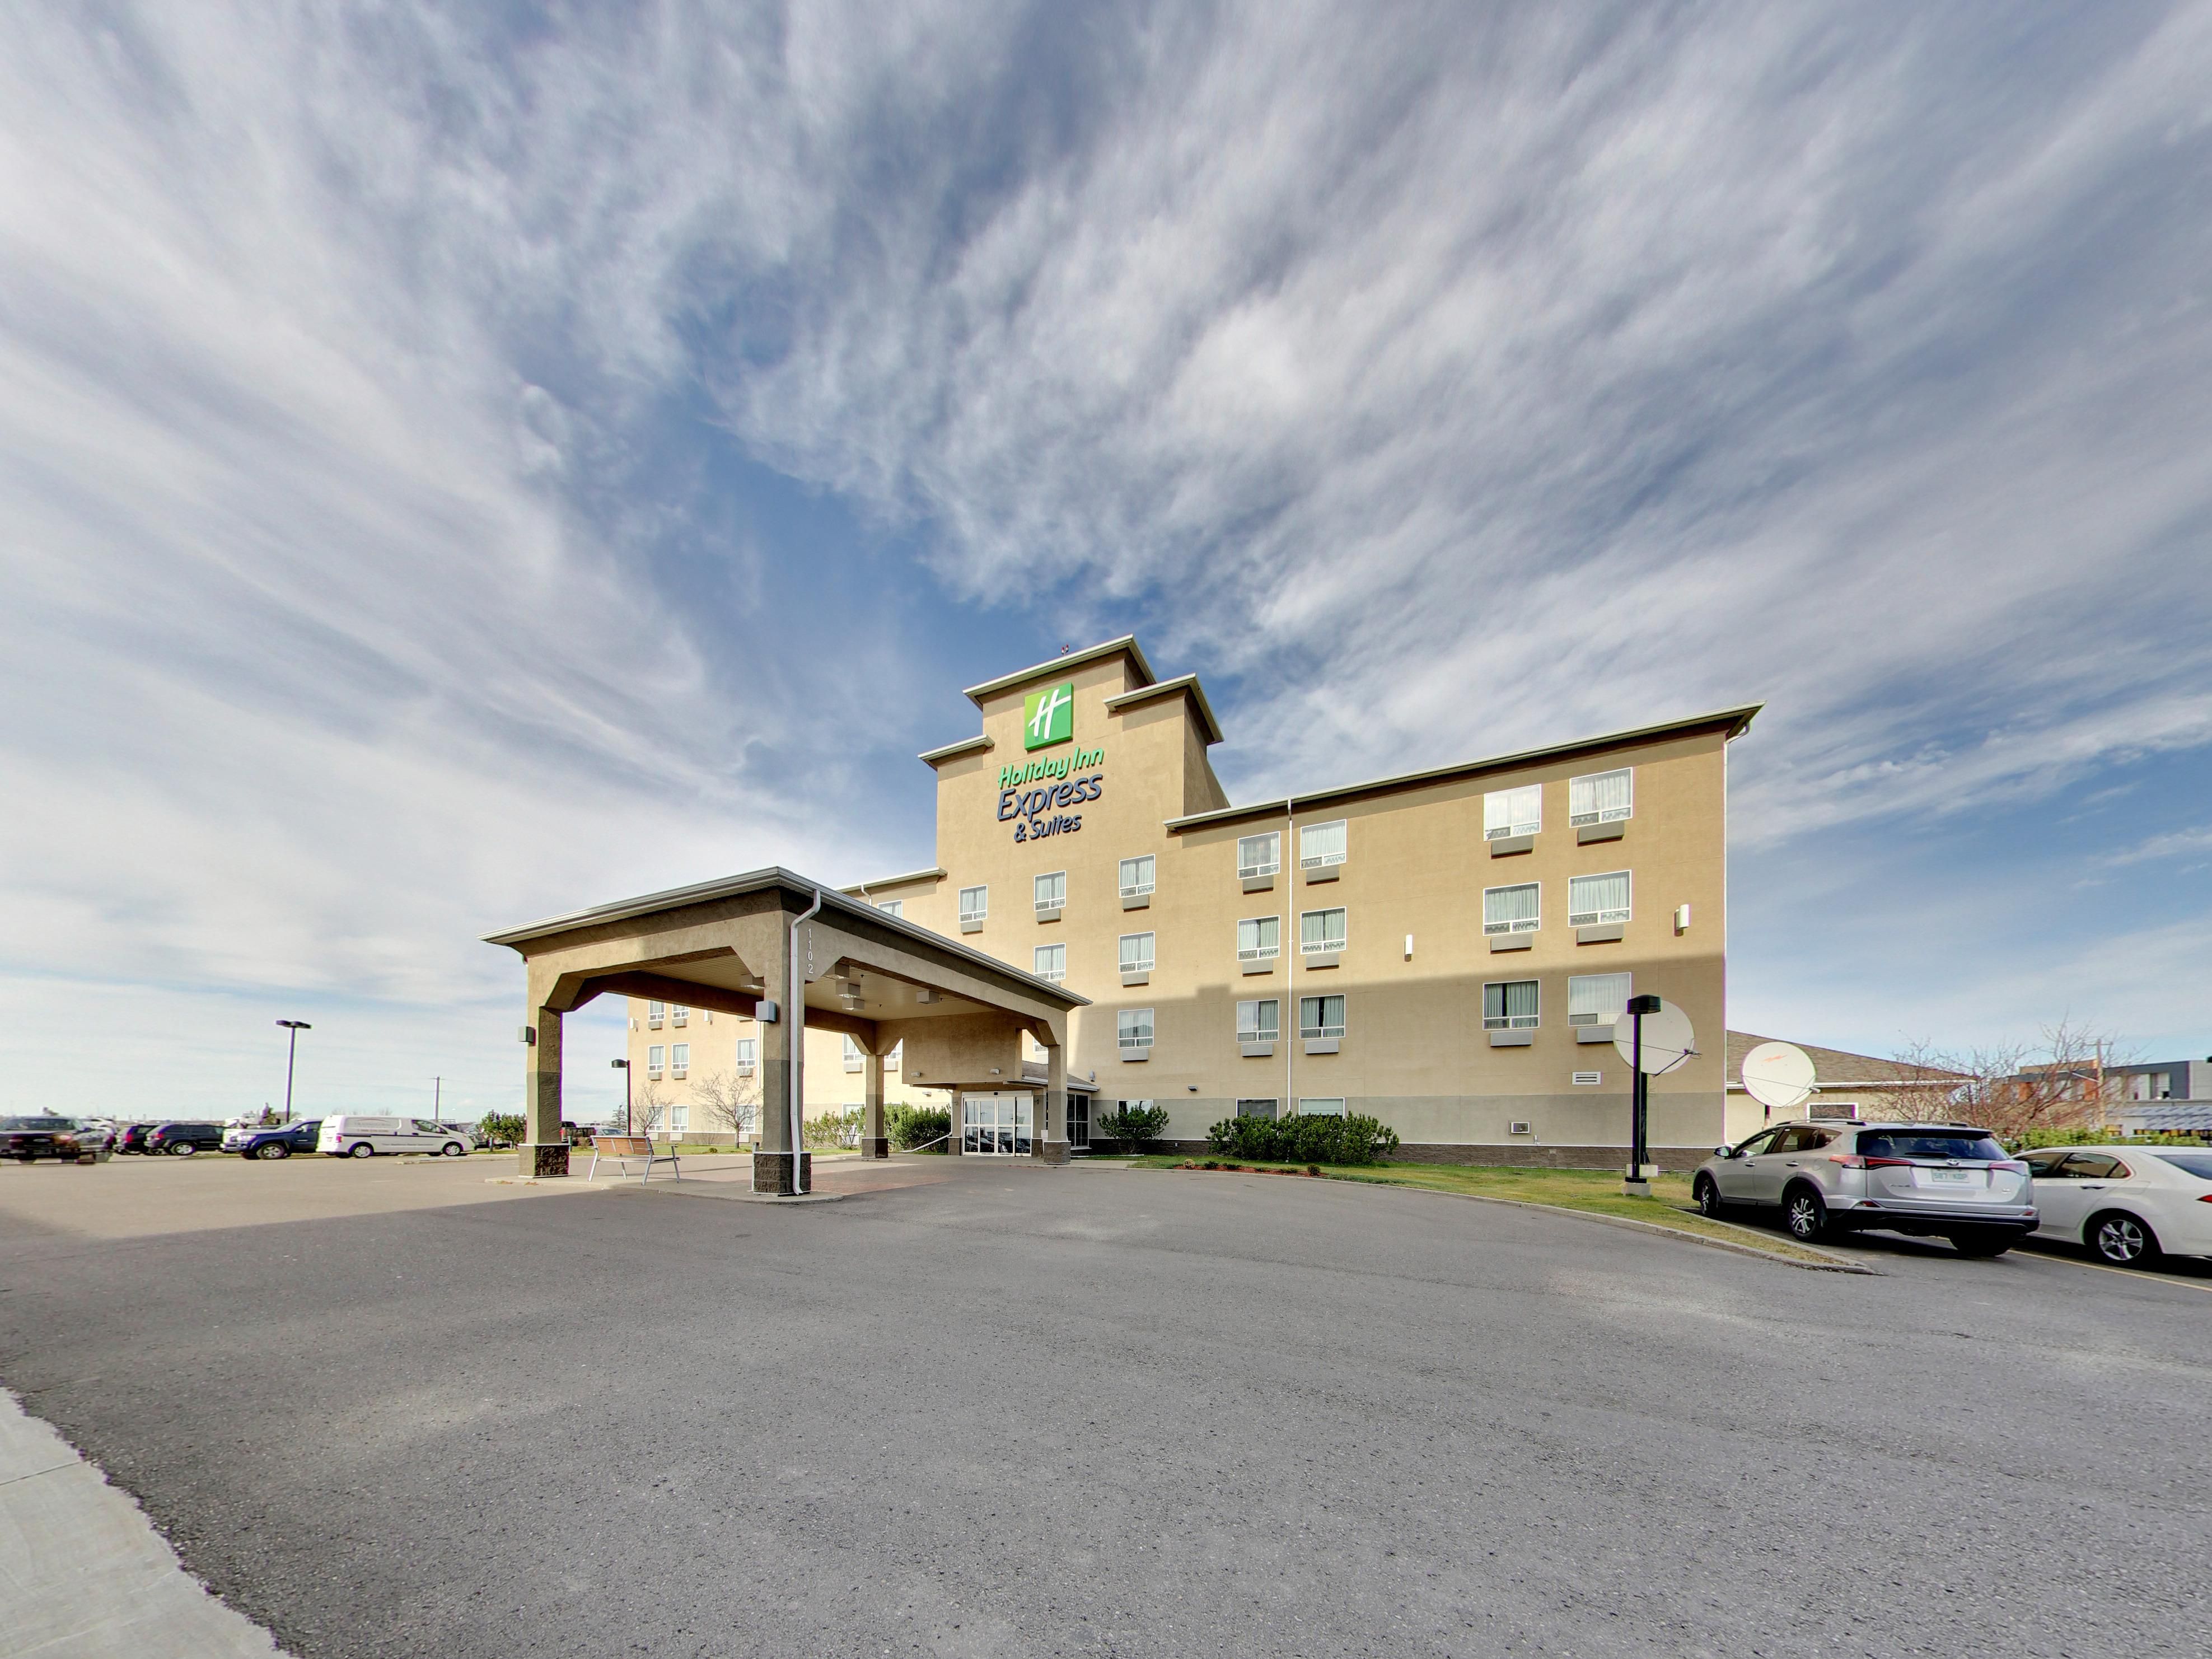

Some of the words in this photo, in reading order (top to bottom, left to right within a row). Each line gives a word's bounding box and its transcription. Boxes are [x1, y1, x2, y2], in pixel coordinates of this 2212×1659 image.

[1028, 689, 1071, 739] H
[998, 756, 1070, 789] Holiday
[1072, 746, 1104, 771] Inn
[997, 774, 1103, 822] Express
[1014, 823, 1026, 843] &
[1030, 815, 1082, 840] Suites
